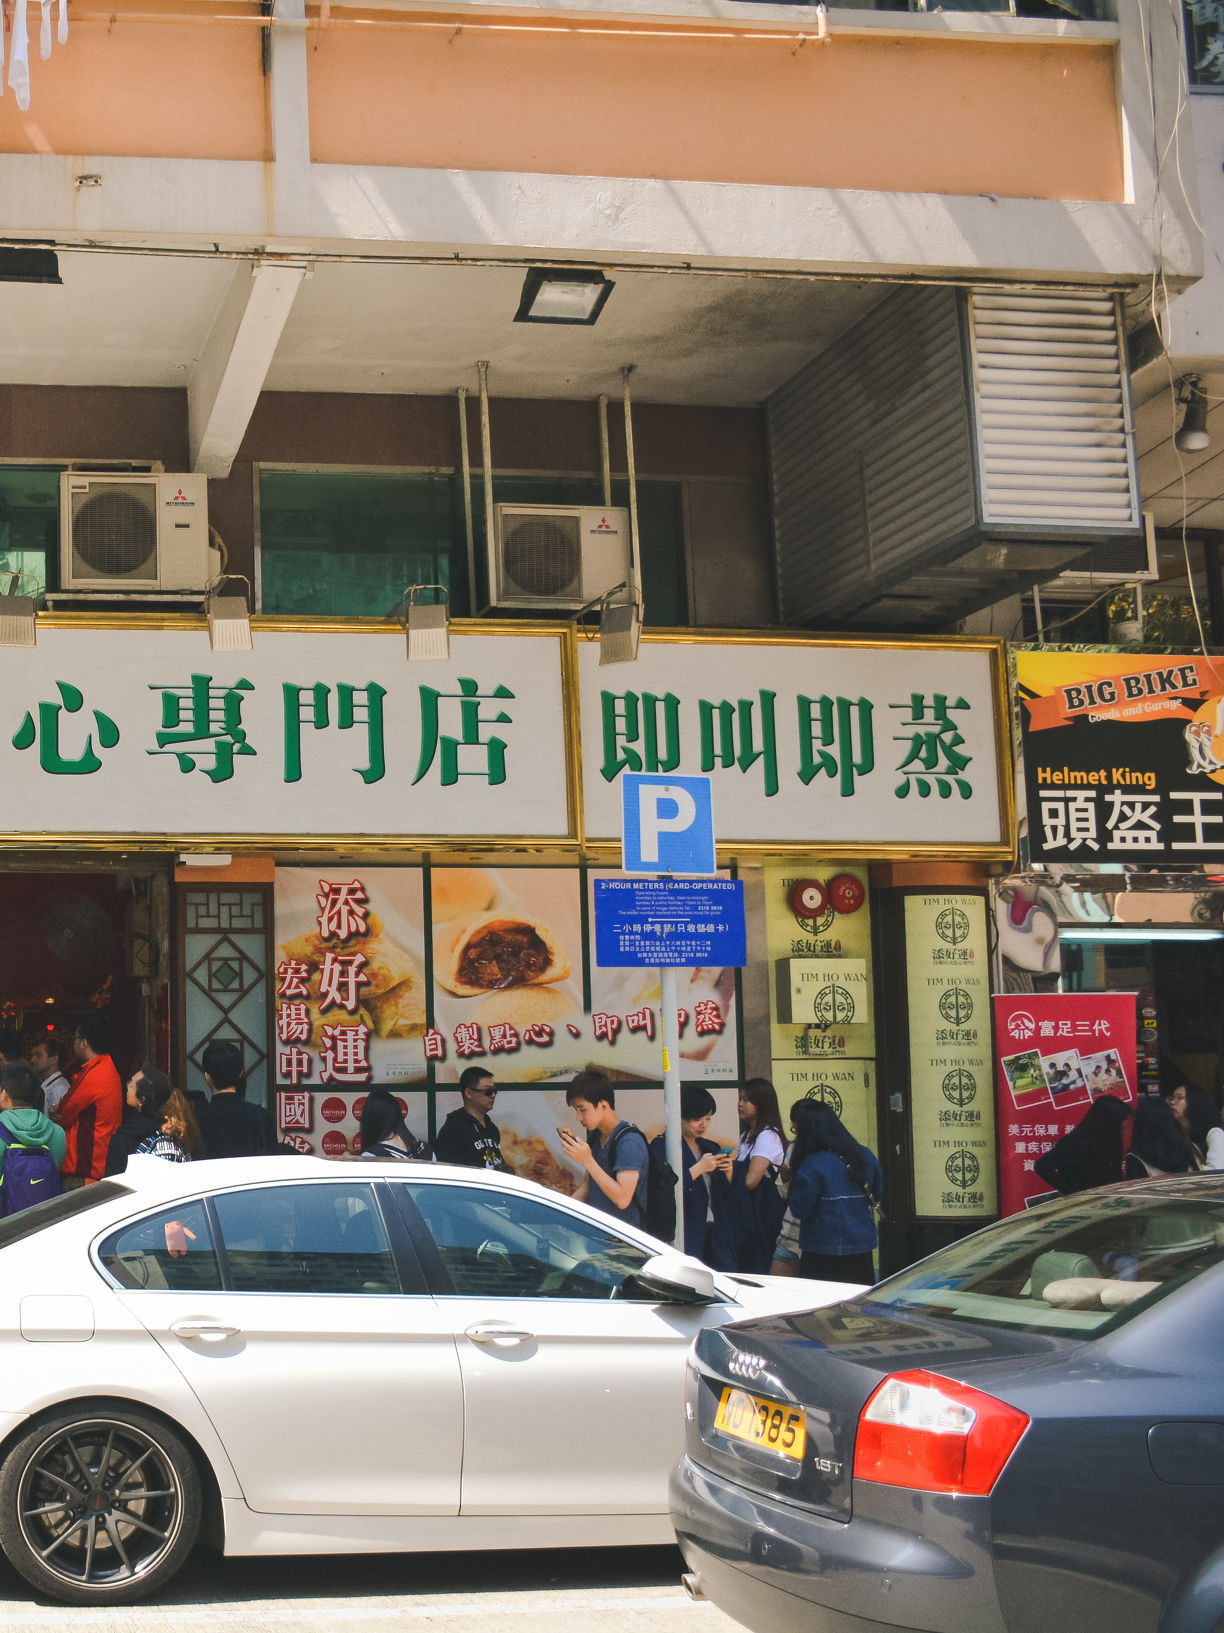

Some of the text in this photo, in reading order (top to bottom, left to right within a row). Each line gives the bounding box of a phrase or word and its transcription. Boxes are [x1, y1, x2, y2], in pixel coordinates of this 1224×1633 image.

[1062, 664, 1199, 711] BIG BIKE
[1088, 698, 1182, 723] Goods and Garage
[599, 689, 973, 799] 即叫即蒸
[1037, 766, 1156, 789] Helmet King
[639, 784, 696, 862] P
[1038, 789, 1224, 851] 頭盔王
[923, 898, 940, 906] TIM
[791, 939, 834, 954] 添好運
[932, 948, 969, 960] 添好運
[316, 879, 369, 1083] 添好運
[800, 972, 868, 982] TIM HO WAN
[926, 978, 944, 986] TIM
[964, 978, 981, 986] WAN
[1039, 1019, 1111, 1037] 富足三代
[936, 1029, 972, 1041] 添好運
[929, 1059, 984, 1067] TIM HO WAN
[789, 1072, 855, 1082] TIM HO WAN
[938, 1110, 975, 1122] 添好運
[1008, 1124, 1059, 1137] 美元保單
[932, 1140, 987, 1148] TIM HO WAN
[941, 1192, 979, 1204] 添好運
